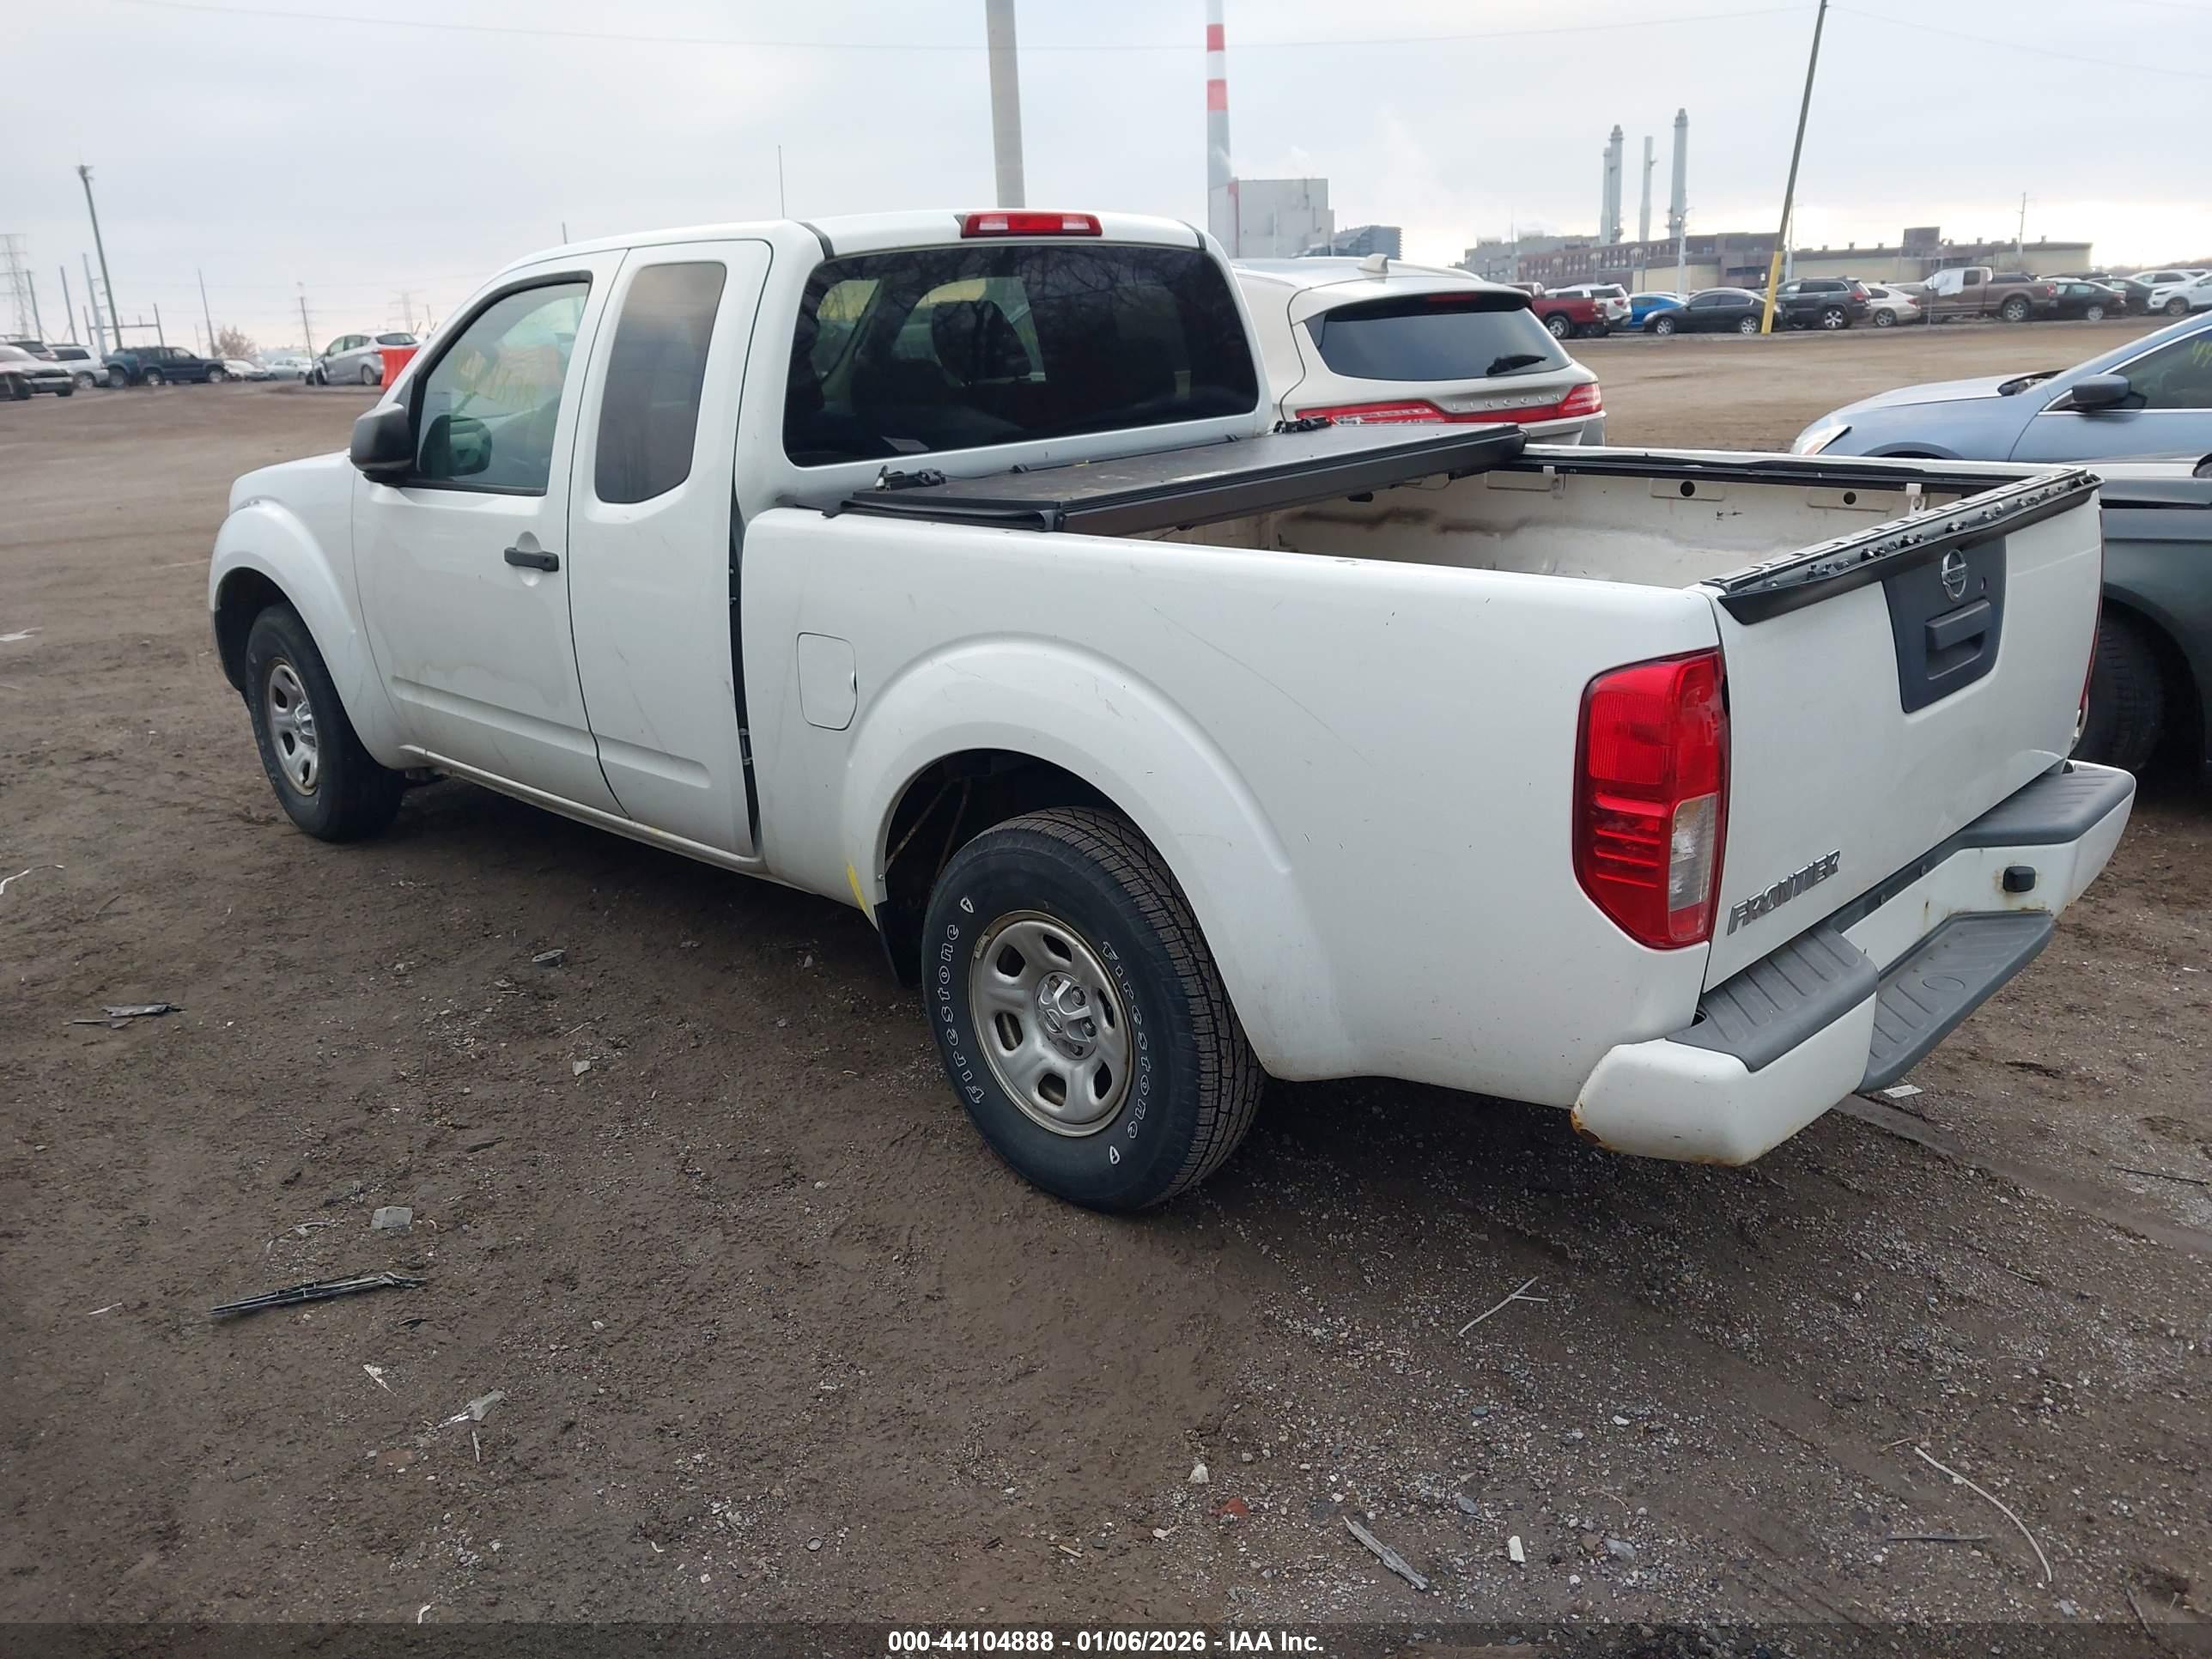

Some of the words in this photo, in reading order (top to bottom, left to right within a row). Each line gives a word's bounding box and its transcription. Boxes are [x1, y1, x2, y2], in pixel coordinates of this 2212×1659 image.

[1450, 392, 1561, 411] LINCOLN
[1727, 848, 1841, 936] FRONTIER
[937, 924, 985, 1104] Firestone
[1102, 940, 1152, 1139] Firestone
